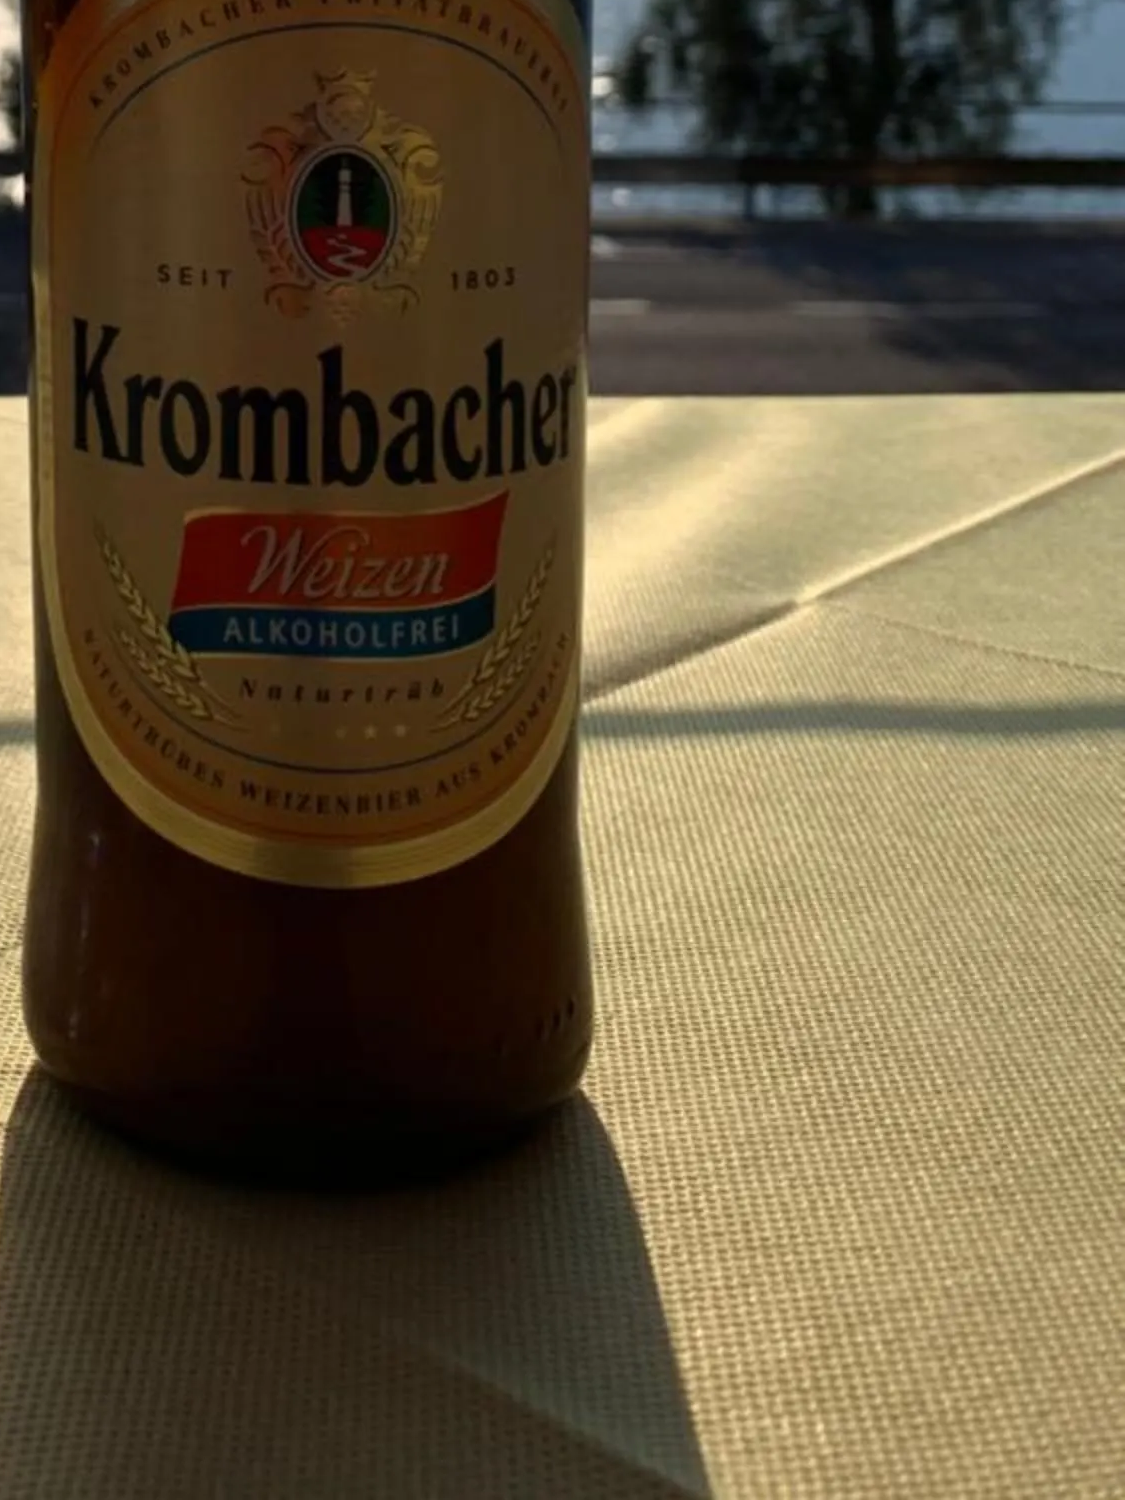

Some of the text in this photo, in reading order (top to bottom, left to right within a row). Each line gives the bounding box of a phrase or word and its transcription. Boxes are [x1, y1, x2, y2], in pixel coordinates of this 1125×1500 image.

[156, 264, 517, 292] SEIT 1803
[74, 316, 574, 487] Krombacher
[240, 525, 449, 600] Weizen
[222, 613, 460, 650] ALKOHOLFREI
[240, 676, 446, 704] Naturtrüb
[239, 778, 423, 816] WEIZENBIER
[434, 761, 483, 799] AUS
